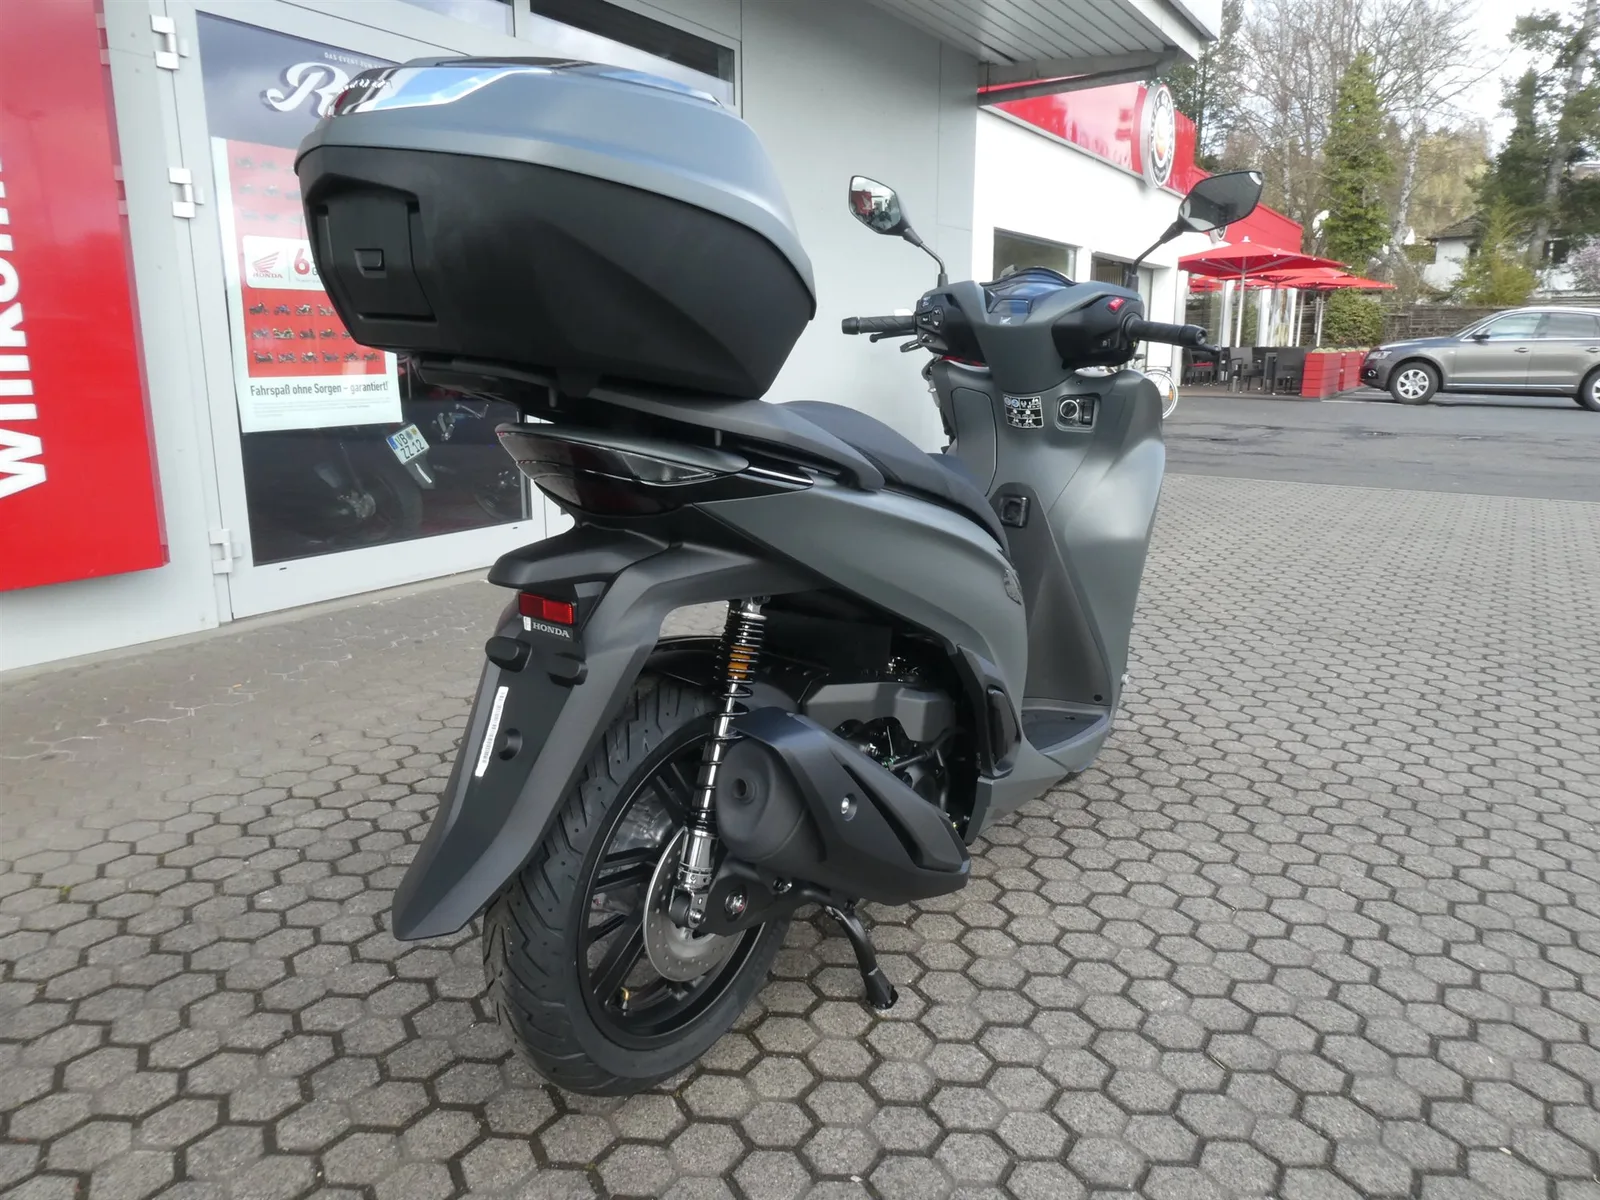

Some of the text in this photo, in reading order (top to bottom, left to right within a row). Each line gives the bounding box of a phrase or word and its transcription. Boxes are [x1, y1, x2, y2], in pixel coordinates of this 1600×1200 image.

[324, 52, 337, 61] DAS
[338, 55, 359, 65] EVENT
[294, 248, 310, 275] 6
[250, 384, 291, 397] Fahrspaß
[292, 384, 313, 395] ohne
[314, 382, 342, 395] Sorgen
[350, 381, 389, 394] garantiert!
[394, 432, 409, 447] VB
[400, 438, 425, 460] ZZ 12
[532, 622, 571, 638] HONDA
